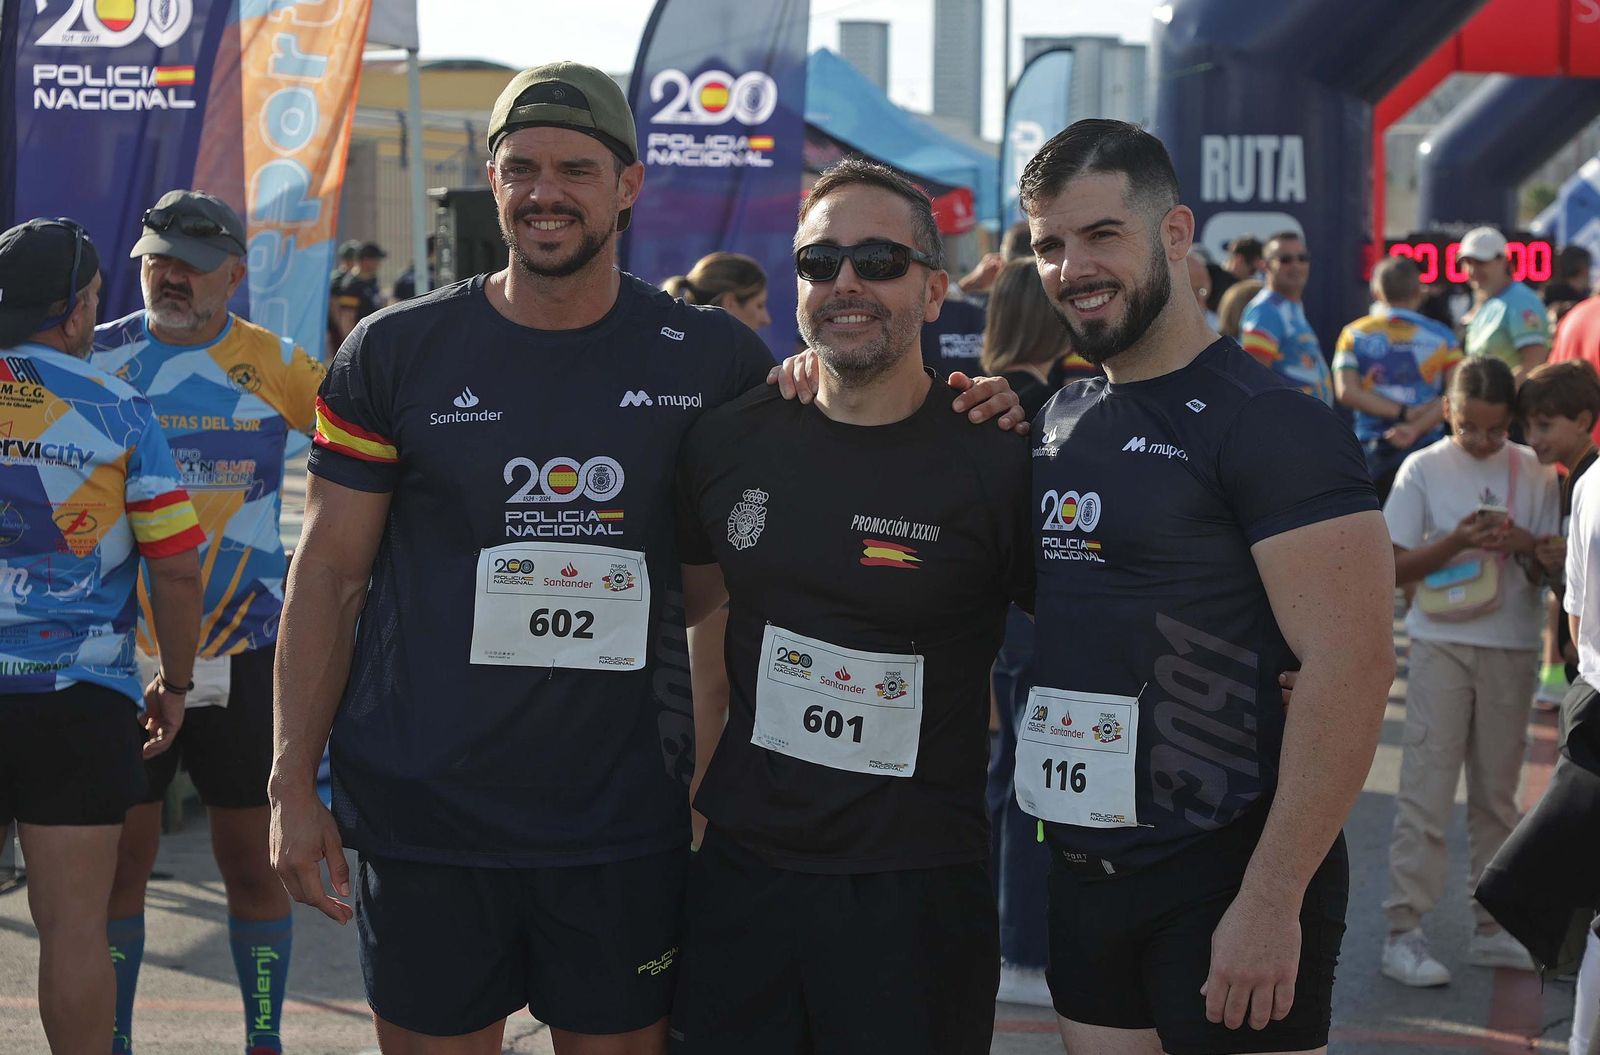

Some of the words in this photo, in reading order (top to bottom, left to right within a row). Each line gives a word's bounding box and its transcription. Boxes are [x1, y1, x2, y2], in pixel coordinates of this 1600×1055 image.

[33, 87, 196, 110] NACIONAL
[650, 69, 778, 126] 200
[647, 150, 774, 168] NACIONAL
[1203, 134, 1306, 202] RUTA
[658, 393, 702, 410] mupol
[202, 416, 229, 431] DEL
[430, 409, 503, 425] Santander
[0, 438, 95, 469] rvicity
[1148, 443, 1189, 461] mupo
[503, 456, 625, 503] 200
[1041, 489, 1101, 533] 200
[505, 524, 624, 536] NACIONAL
[851, 515, 910, 538] PROMOCIÓN
[910, 522, 940, 542] XXXIII
[1044, 549, 1105, 563] NACIONAL
[494, 558, 535, 574] 200
[543, 577, 593, 589] Santander
[529, 608, 595, 639] 602
[776, 646, 813, 668] 200
[820, 675, 867, 694] Santander
[803, 704, 864, 743] 601
[1050, 725, 1085, 739] Santander
[1042, 758, 1087, 793] 116
[651, 959, 672, 975] CNP
